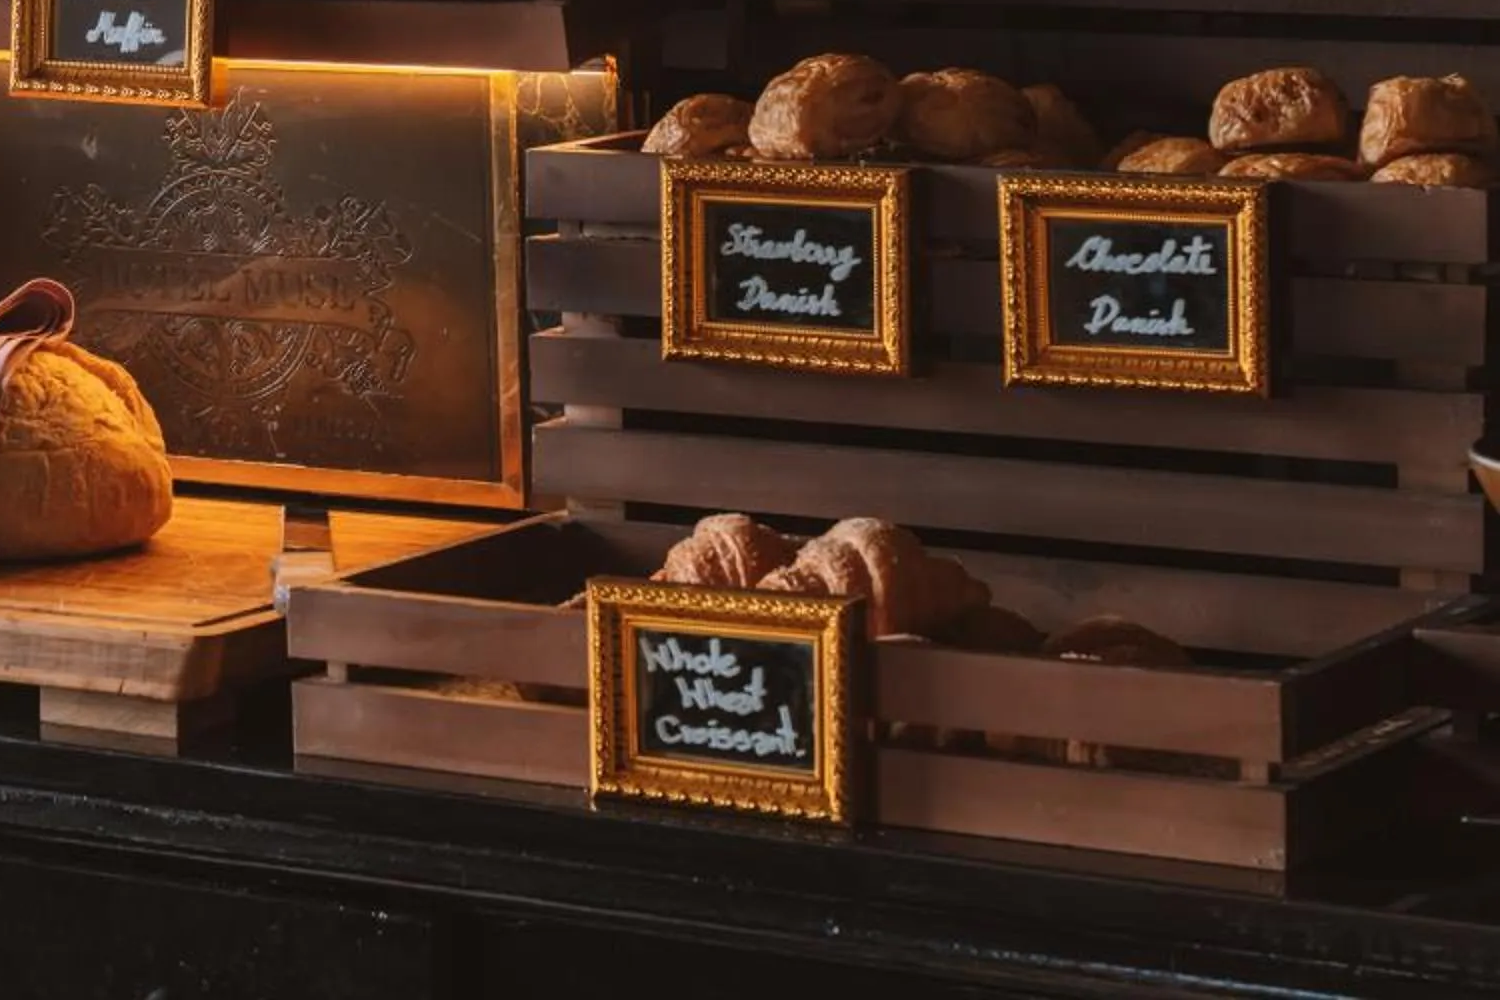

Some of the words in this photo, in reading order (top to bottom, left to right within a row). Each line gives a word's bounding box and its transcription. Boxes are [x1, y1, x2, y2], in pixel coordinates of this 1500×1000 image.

[1065, 234, 1217, 275] Chocolate
[736, 276, 842, 318] Danish
[1083, 295, 1196, 336] Danish
[638, 637, 741, 678] Whole
[674, 667, 768, 716] Wheat
